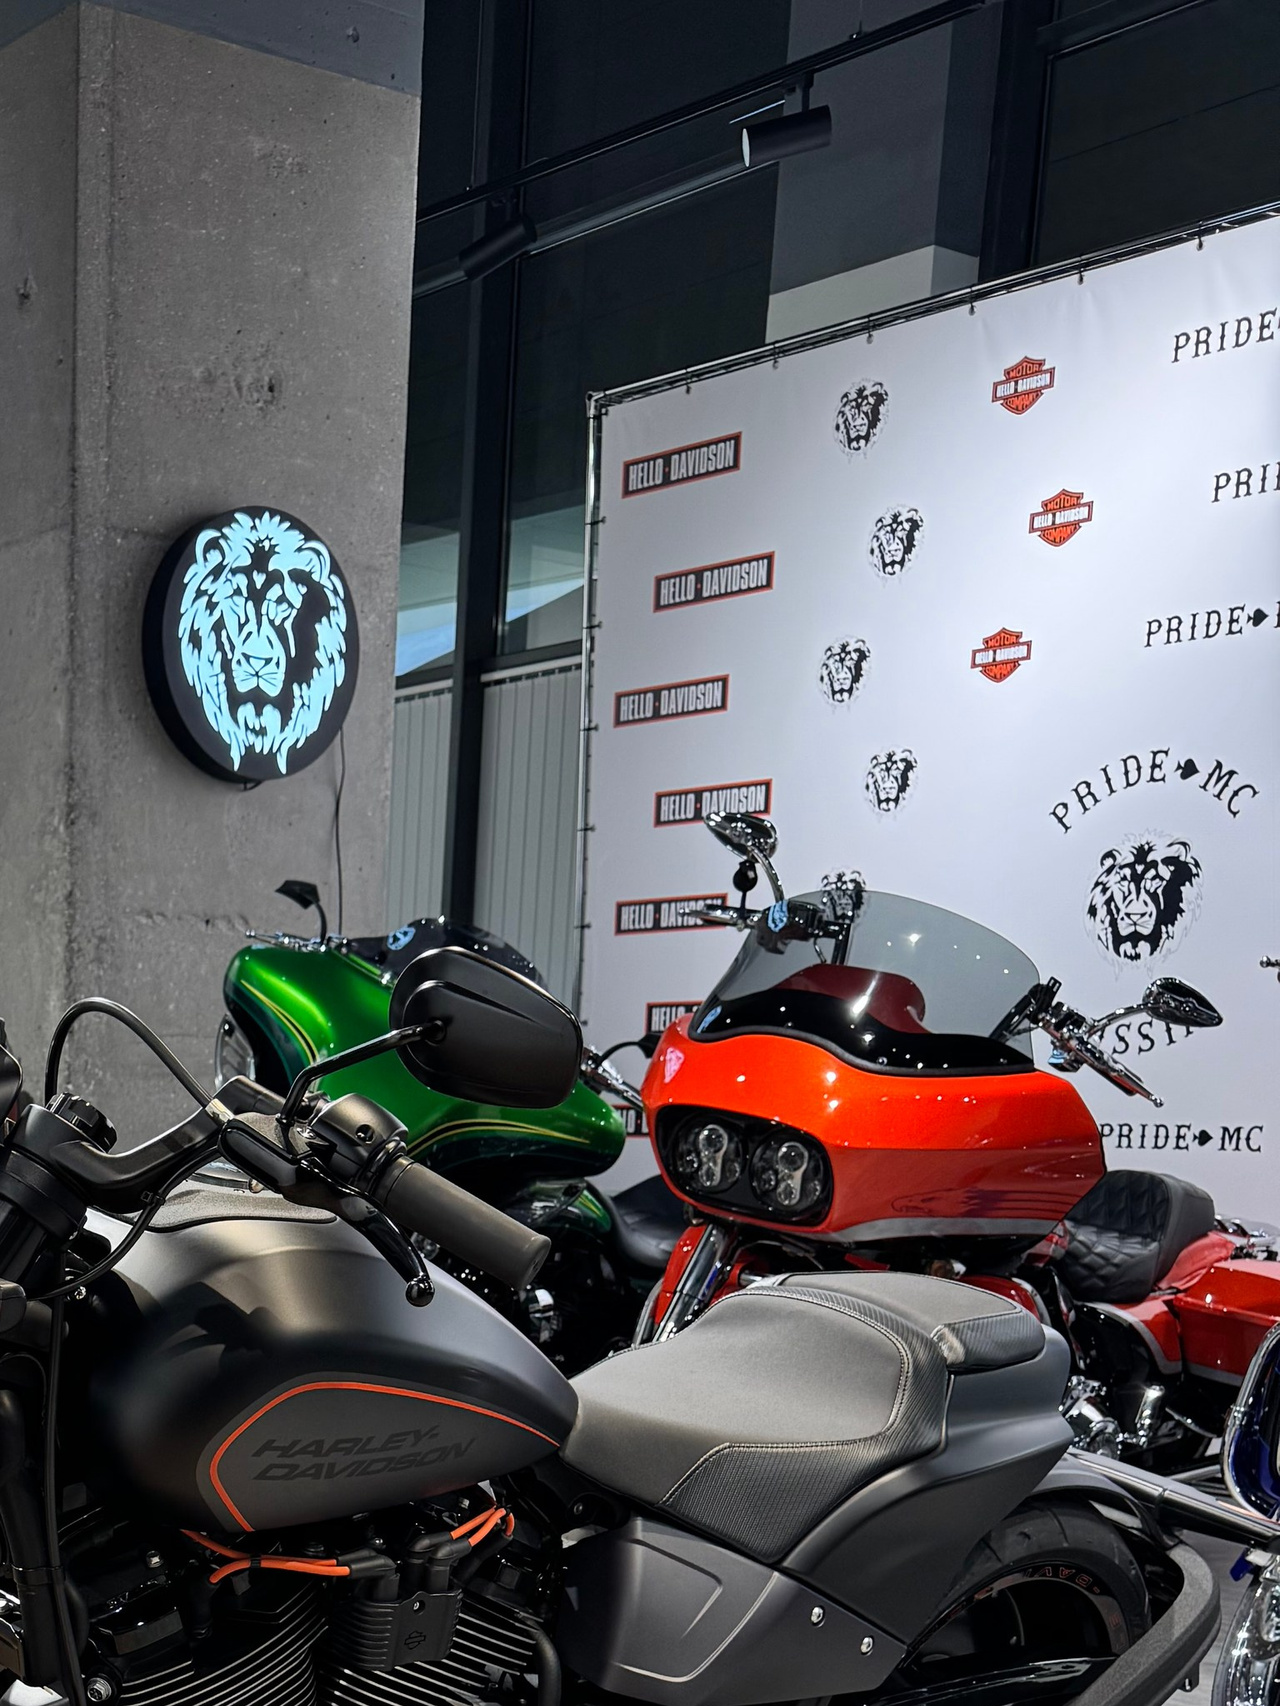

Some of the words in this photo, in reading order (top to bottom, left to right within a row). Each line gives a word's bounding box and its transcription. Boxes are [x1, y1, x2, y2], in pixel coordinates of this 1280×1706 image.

[1171, 307, 1278, 363] PRIDE
[628, 458, 664, 492] HELLO
[670, 439, 735, 481] DAVIDSON
[1211, 463, 1280, 504] PRI
[660, 574, 696, 606] HELLO
[702, 559, 768, 598] DAVIDSON
[1144, 604, 1247, 648] PRIDE
[620, 692, 654, 722] HELLO
[660, 681, 723, 716] DAVIDSON
[660, 793, 695, 822] HELLO
[1048, 747, 1171, 834] PRIDE
[1198, 759, 1261, 819] MC
[620, 903, 654, 931] HELLO
[1100, 1123, 1191, 1151] PRIDE
[1218, 1125, 1264, 1153] MC
[251, 1438, 476, 1482] DAVIDSON
